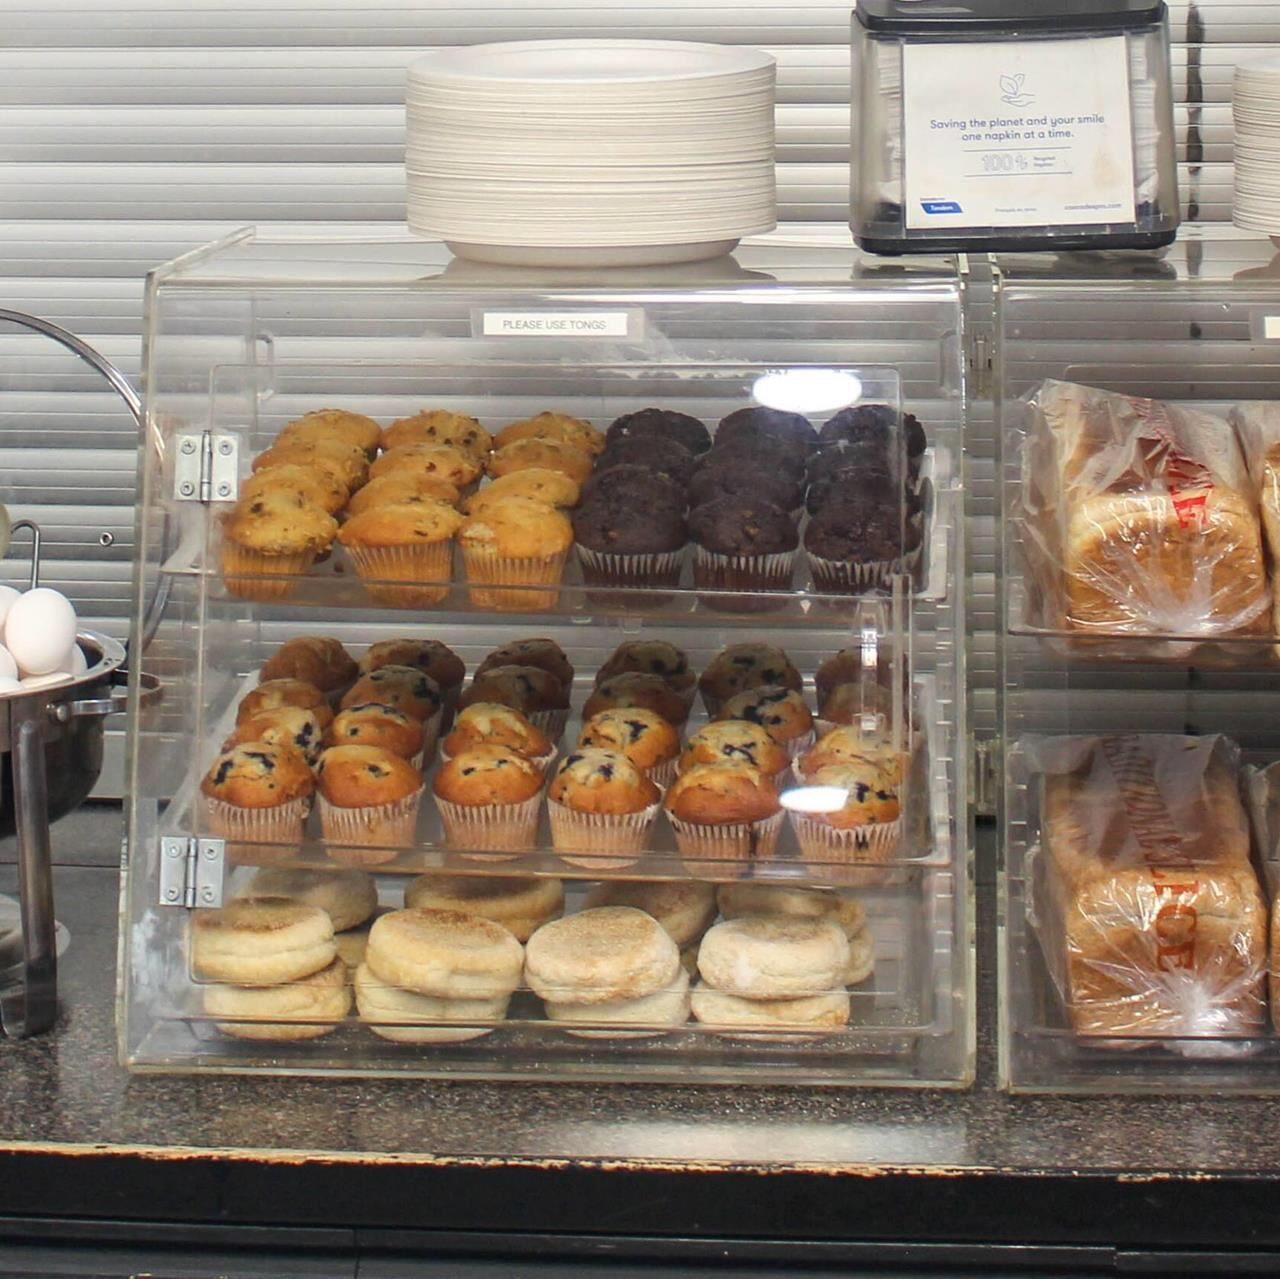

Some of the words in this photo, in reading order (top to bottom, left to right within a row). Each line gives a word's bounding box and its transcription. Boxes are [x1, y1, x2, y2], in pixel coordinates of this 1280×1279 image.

[930, 119, 967, 131] Saving
[969, 118, 987, 128] the
[989, 116, 1024, 131] planet
[1026, 117, 1048, 127] and
[1050, 117, 1075, 128] your
[1077, 114, 1105, 124] smile
[962, 133, 982, 141] one
[985, 129, 1021, 143] napkin
[1024, 130, 1036, 139] at
[1038, 131, 1046, 139] a
[1048, 129, 1075, 139] time.
[503, 320, 542, 329] PLEASE
[546, 320, 568, 329] USE
[570, 320, 607, 330] TONGS
